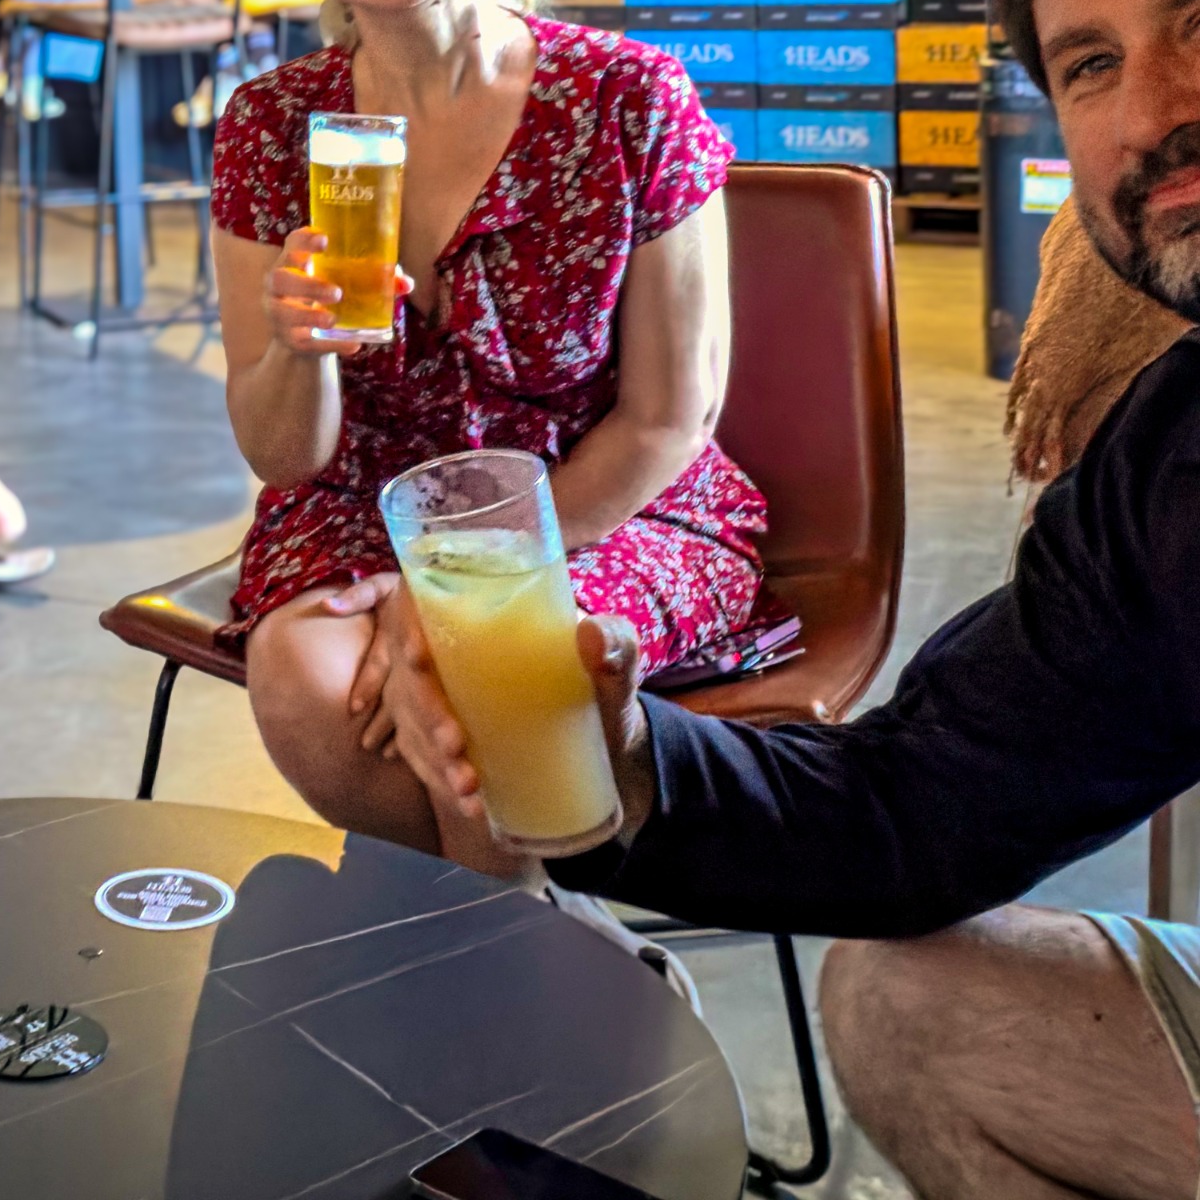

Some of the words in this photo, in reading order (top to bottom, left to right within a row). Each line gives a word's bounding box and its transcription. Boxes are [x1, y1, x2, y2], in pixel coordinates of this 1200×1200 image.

[784, 44, 870, 67] HEADS
[781, 123, 870, 148] HEADS
[319, 183, 375, 201] HEADS
